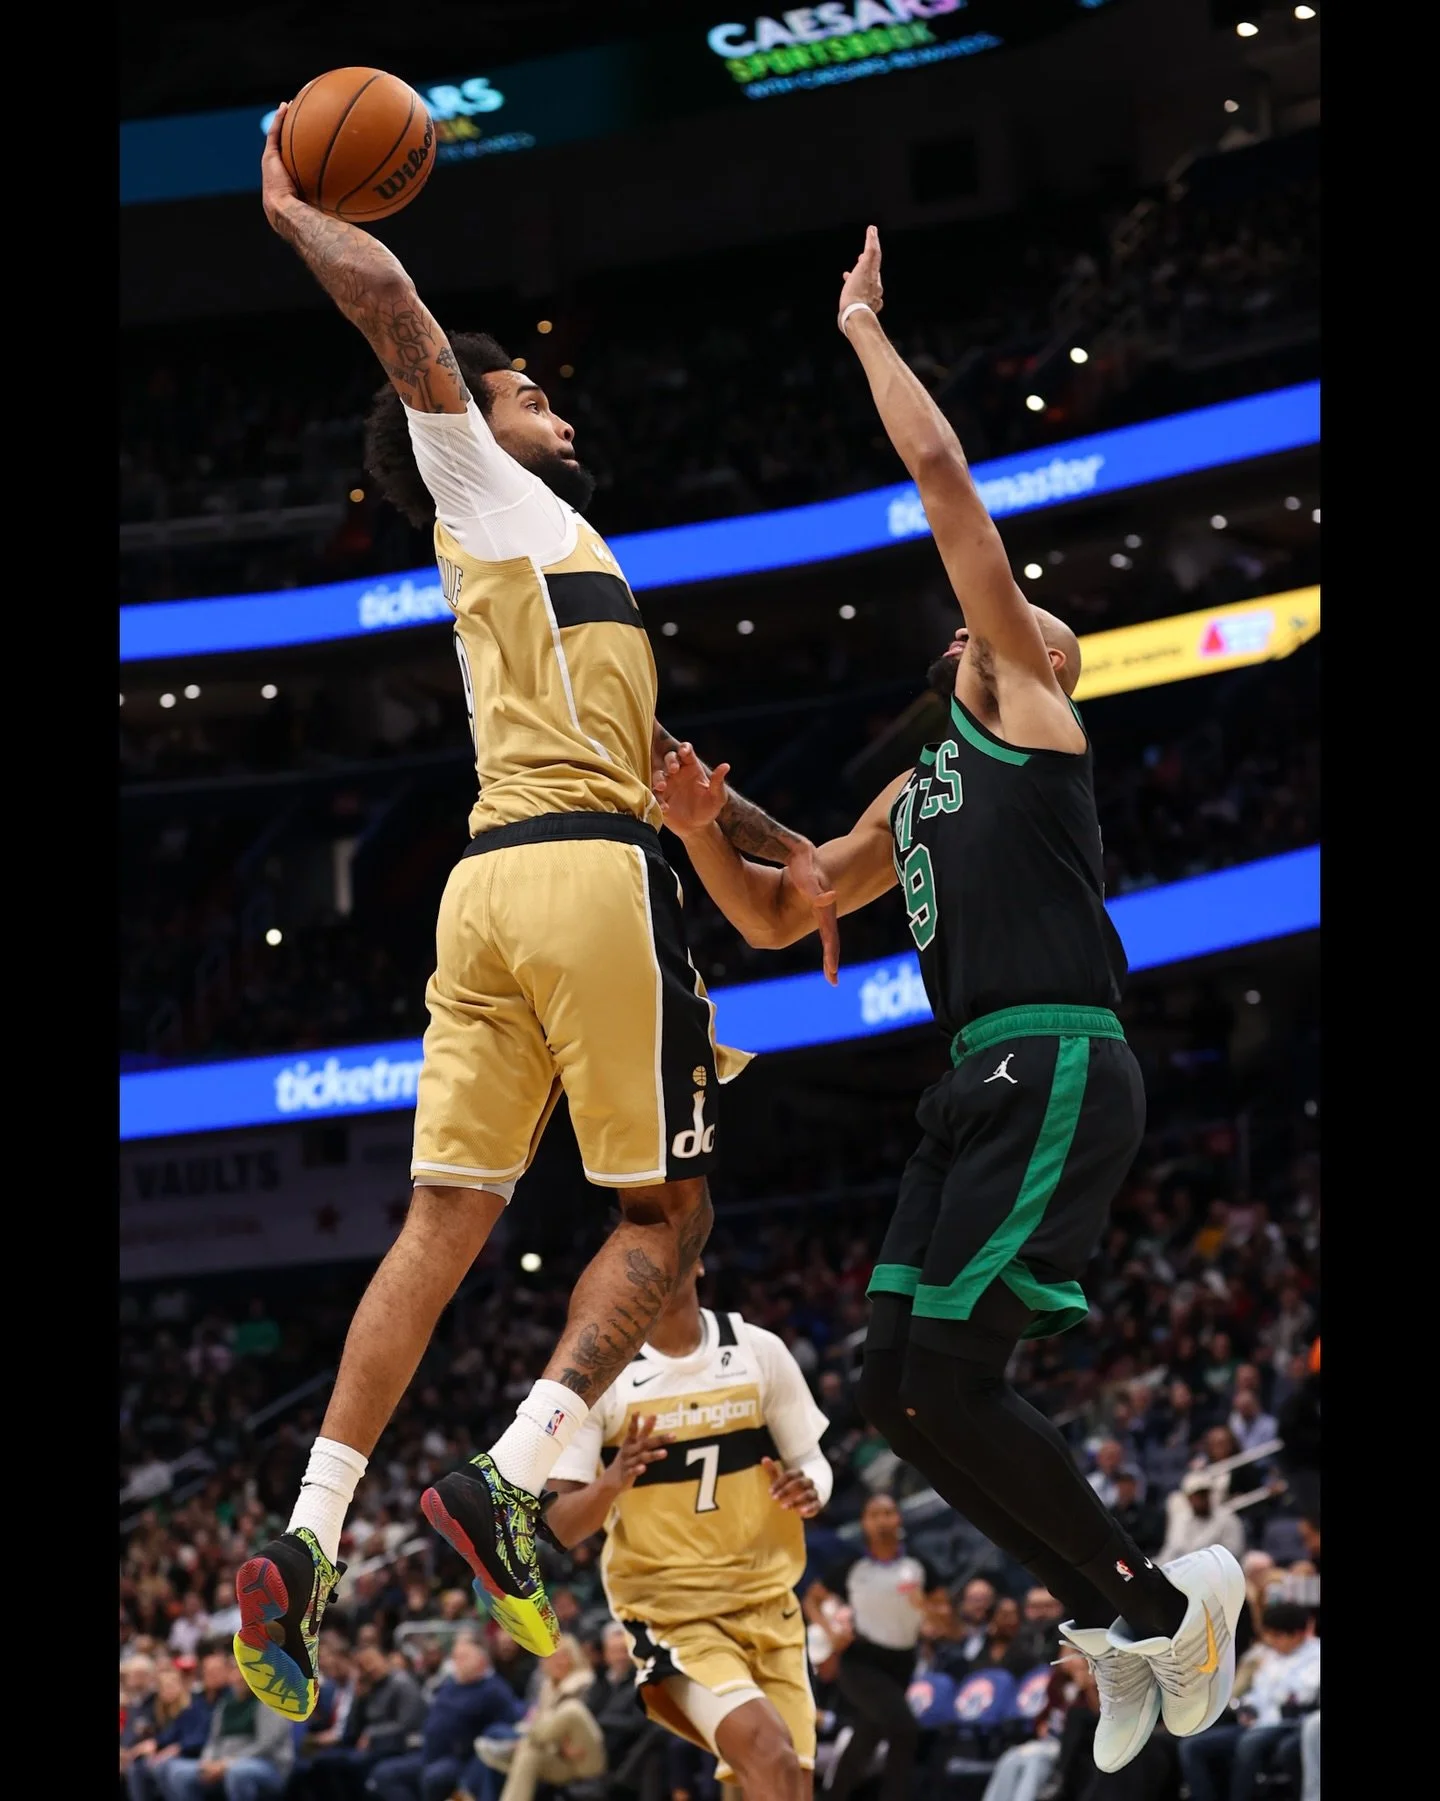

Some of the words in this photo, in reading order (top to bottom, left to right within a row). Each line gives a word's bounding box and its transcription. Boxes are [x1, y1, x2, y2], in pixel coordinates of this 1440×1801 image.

[373, 113, 434, 199] Wilson
[904, 843, 938, 952] 9
[134, 1150, 282, 1200] VAULTS
[637, 1399, 757, 1429] ashington
[685, 1444, 719, 1514] 7
